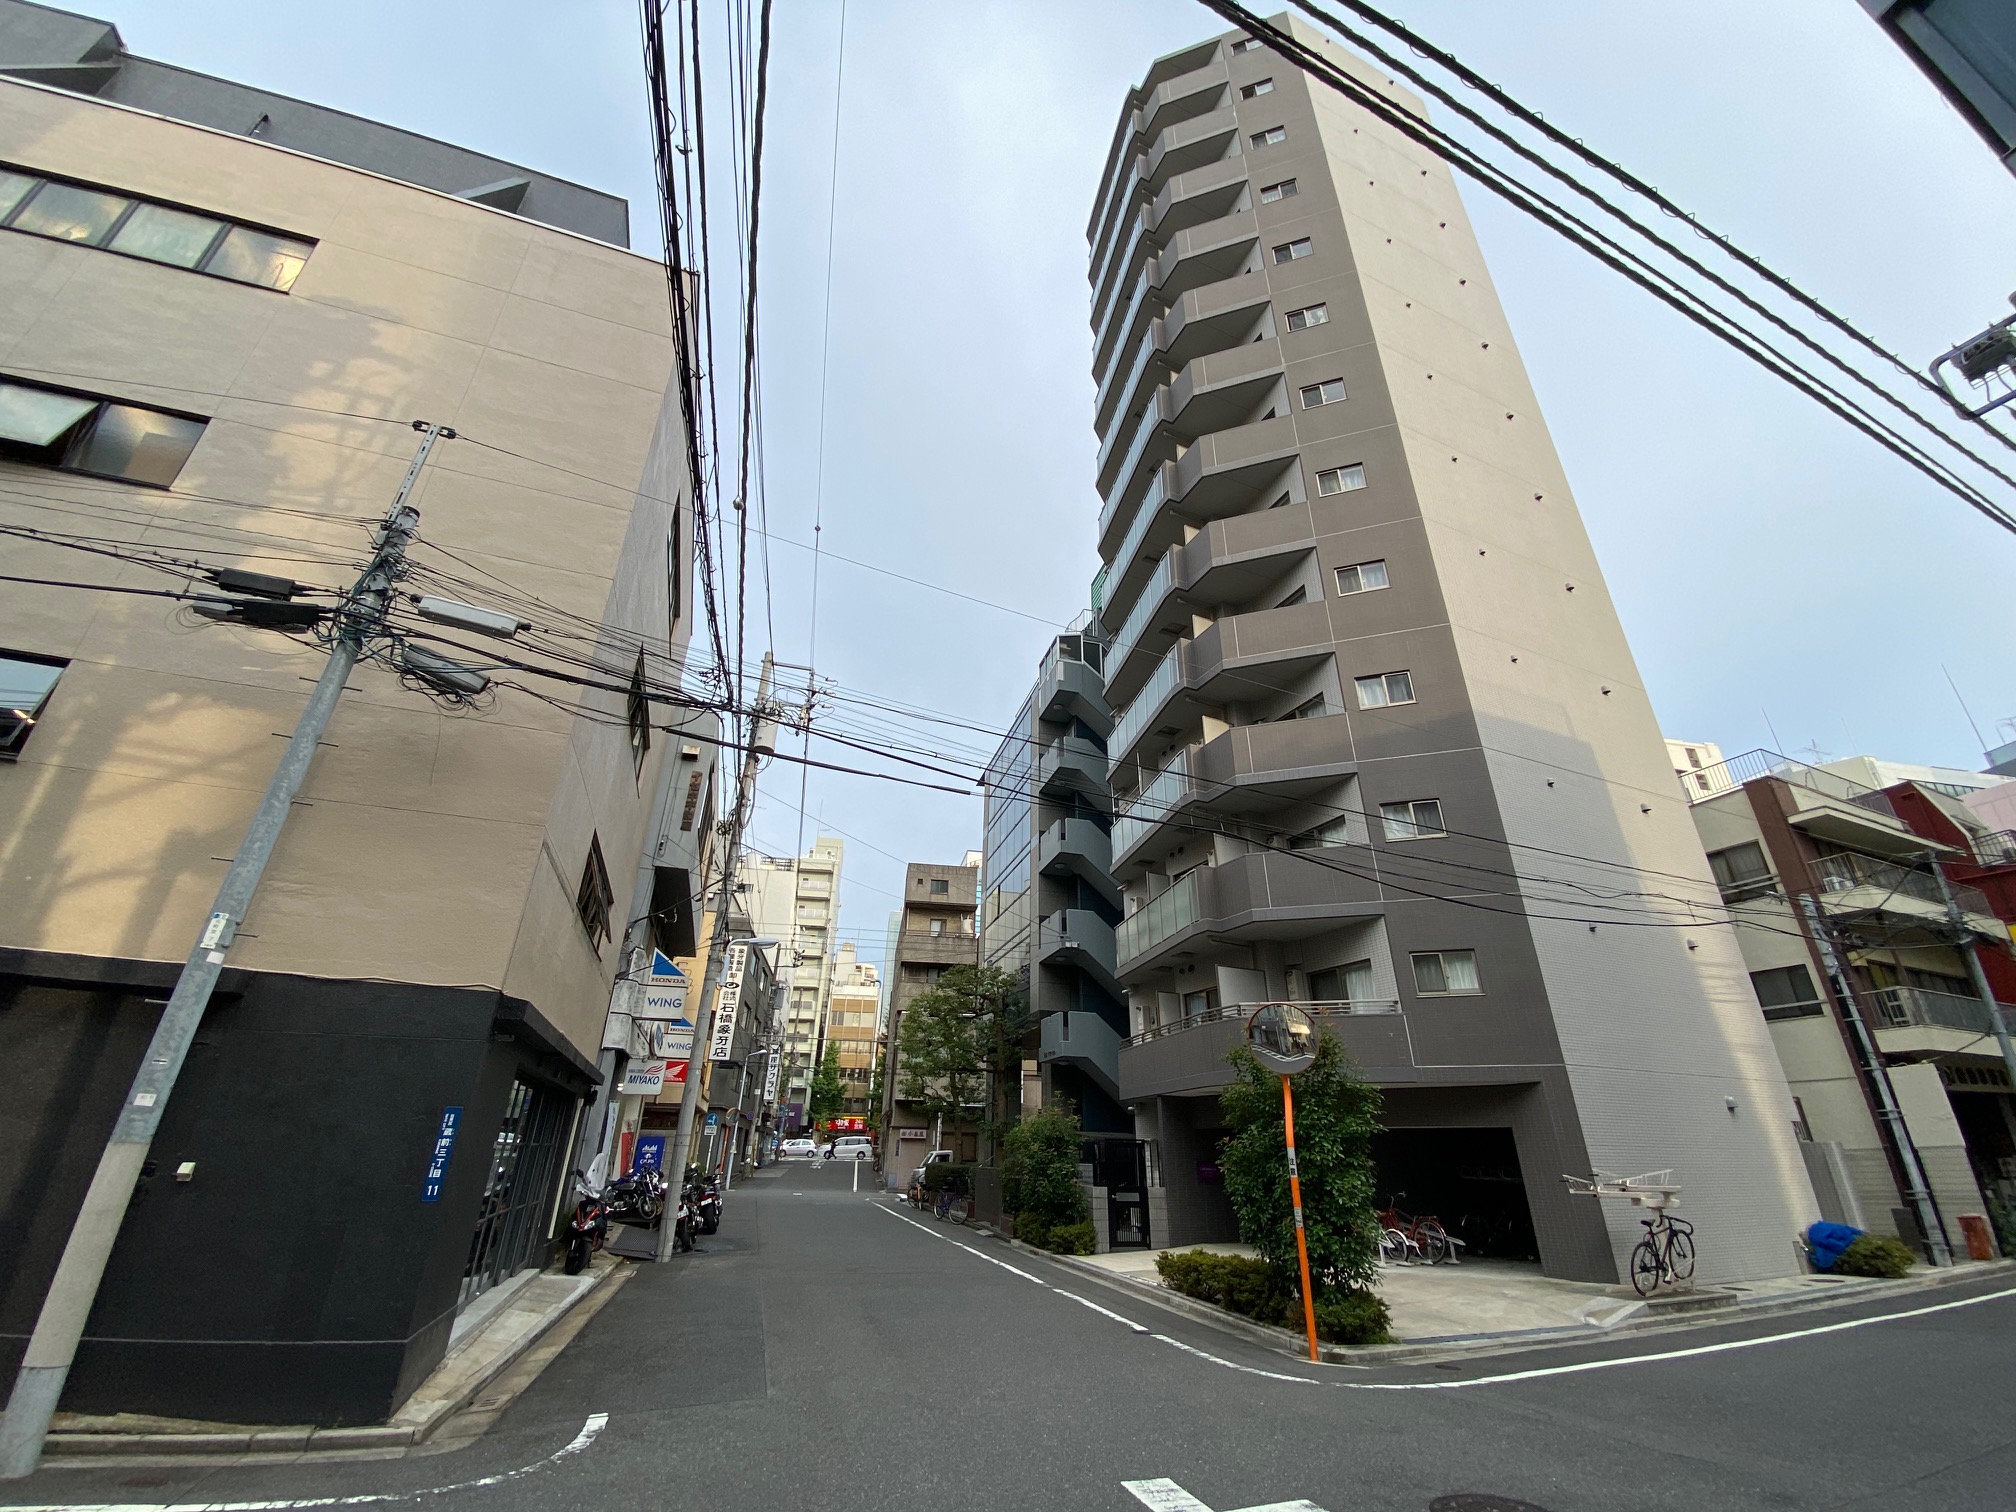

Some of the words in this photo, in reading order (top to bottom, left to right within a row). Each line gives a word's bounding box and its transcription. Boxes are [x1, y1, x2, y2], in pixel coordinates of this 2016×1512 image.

[647, 997, 682, 1008] WING
[713, 1003, 735, 1057] 石橋象牙店
[667, 1042, 692, 1050] WING
[628, 1075, 660, 1085] MIYAKO
[1289, 1157, 1298, 1176] 注意
[427, 1185, 439, 1196] 11
